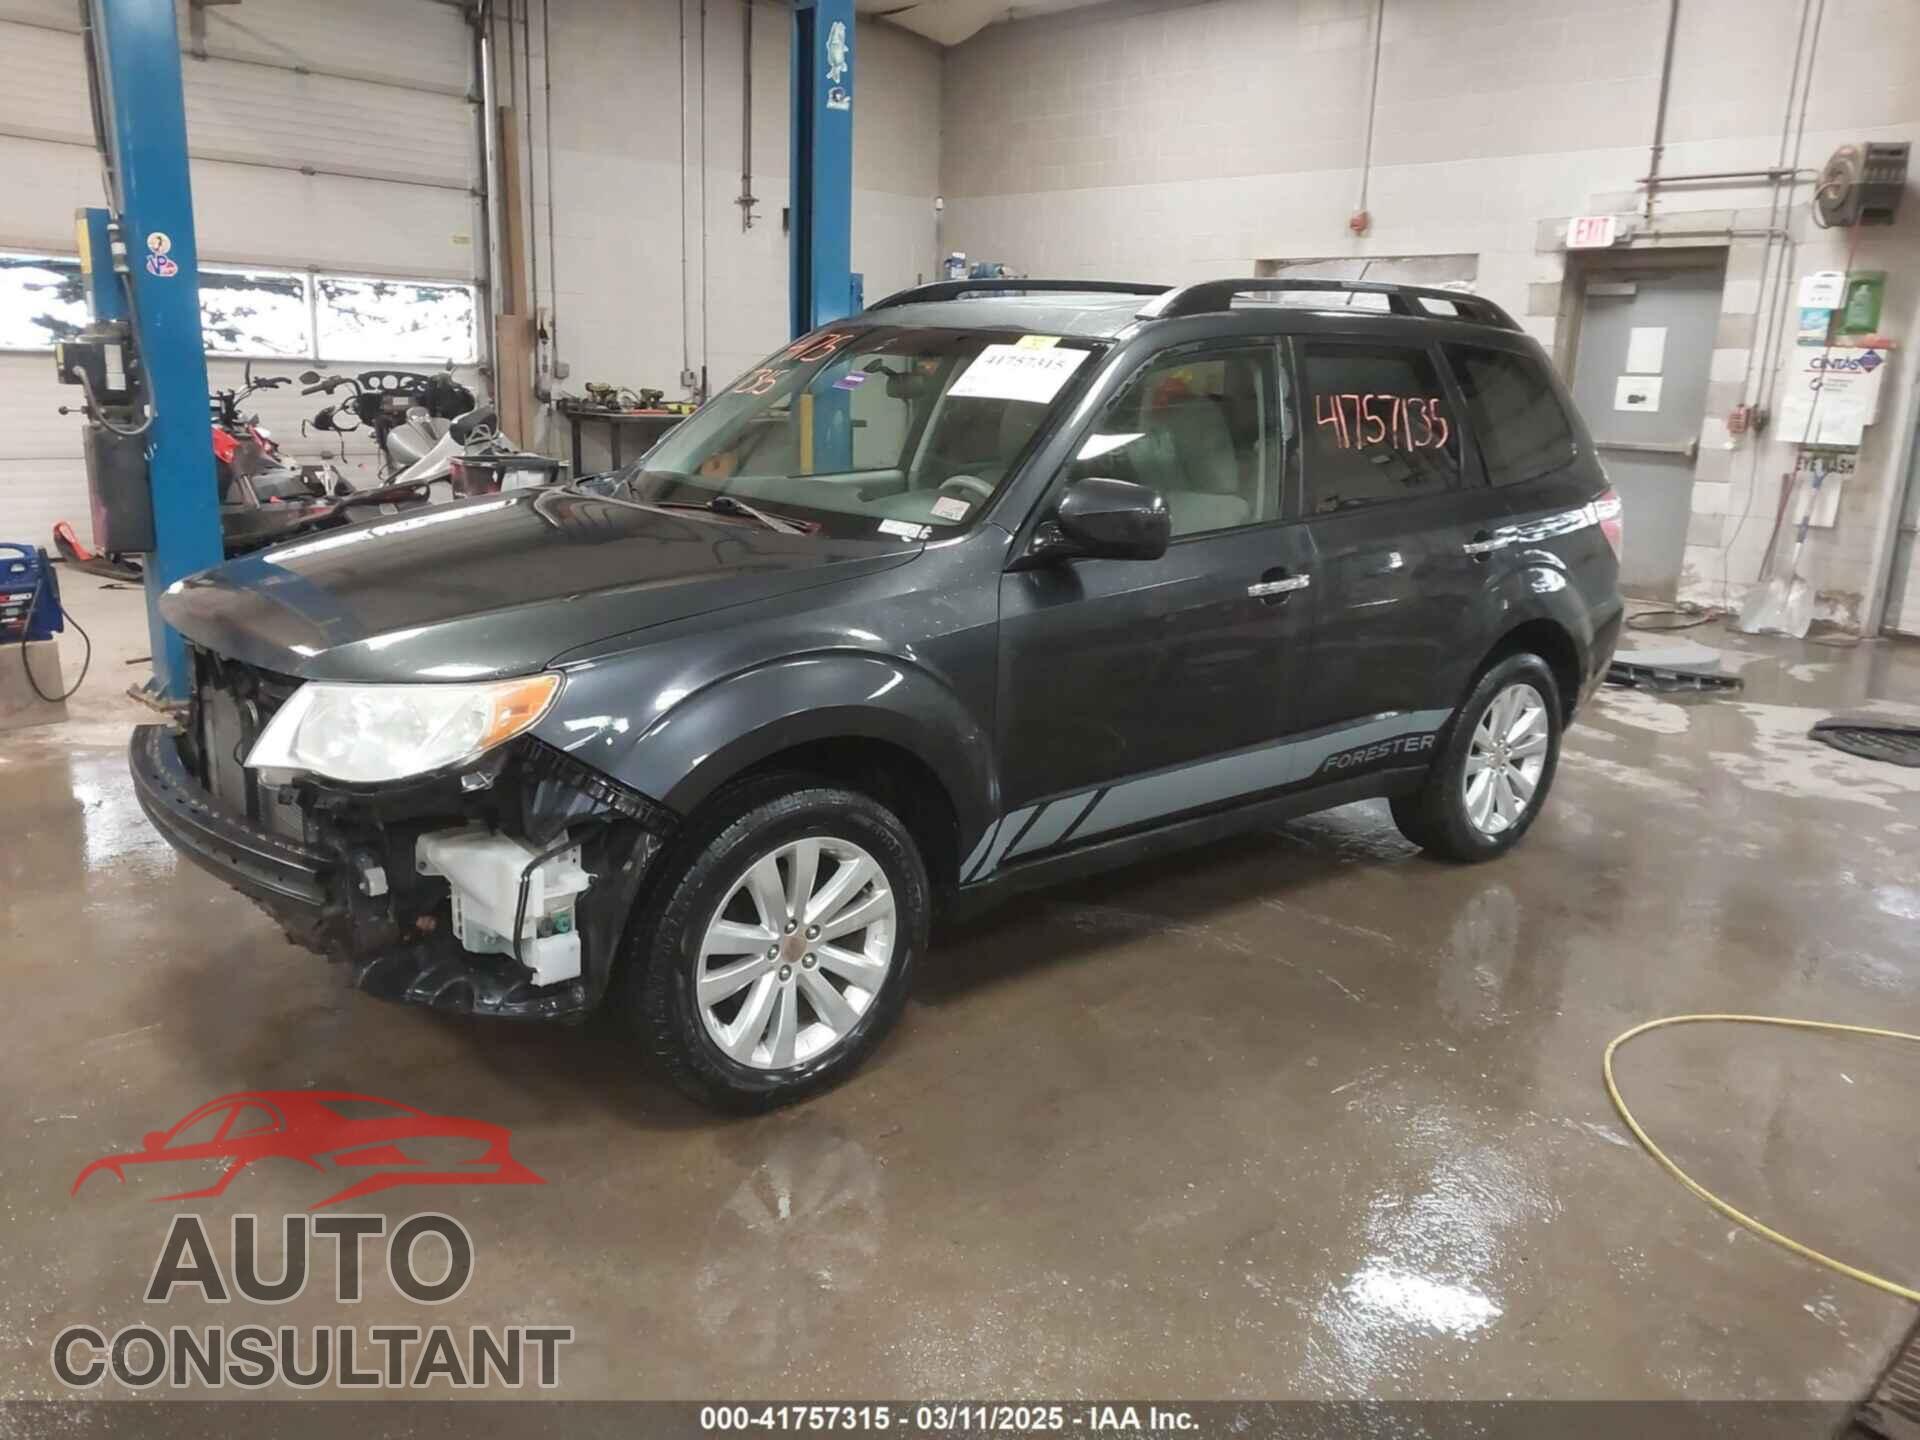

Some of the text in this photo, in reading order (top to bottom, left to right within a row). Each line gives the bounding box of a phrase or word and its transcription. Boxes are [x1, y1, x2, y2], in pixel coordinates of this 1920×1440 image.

[1576, 217, 1609, 245] EXIT
[1809, 356, 1861, 370] CINTAS
[1322, 734, 1436, 773] FORESTER
